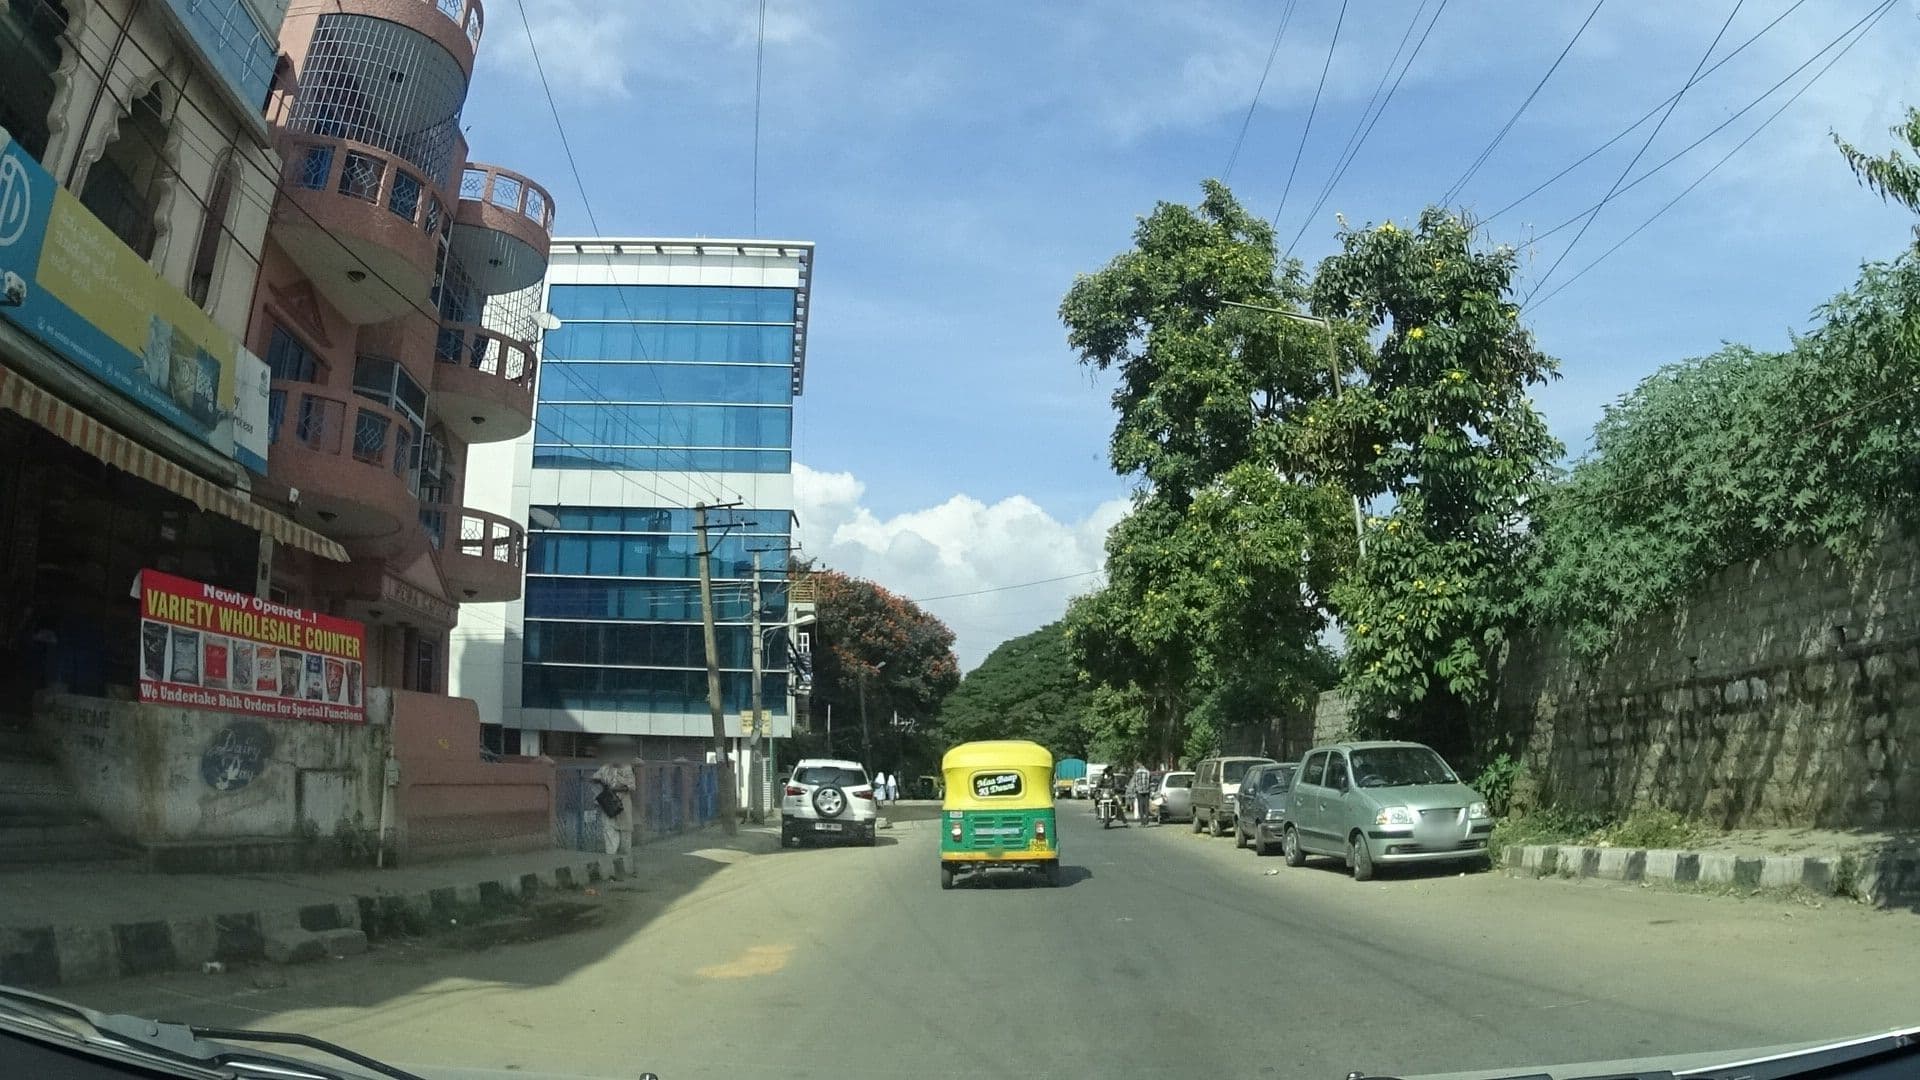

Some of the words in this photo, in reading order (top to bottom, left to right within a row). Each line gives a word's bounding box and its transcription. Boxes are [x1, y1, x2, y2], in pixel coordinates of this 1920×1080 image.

[203, 583, 249, 609] Newly
[146, 588, 214, 627] VARIETY
[219, 606, 302, 647] WHOLESALE
[305, 626, 360, 658] COUNTER
[141, 683, 158, 700] We
[160, 685, 217, 706] Undertake
[219, 694, 243, 709] Bulk
[244, 698, 275, 713] Orders
[278, 701, 291, 714] for
[292, 702, 323, 718] Special
[324, 706, 363, 721] Functions
